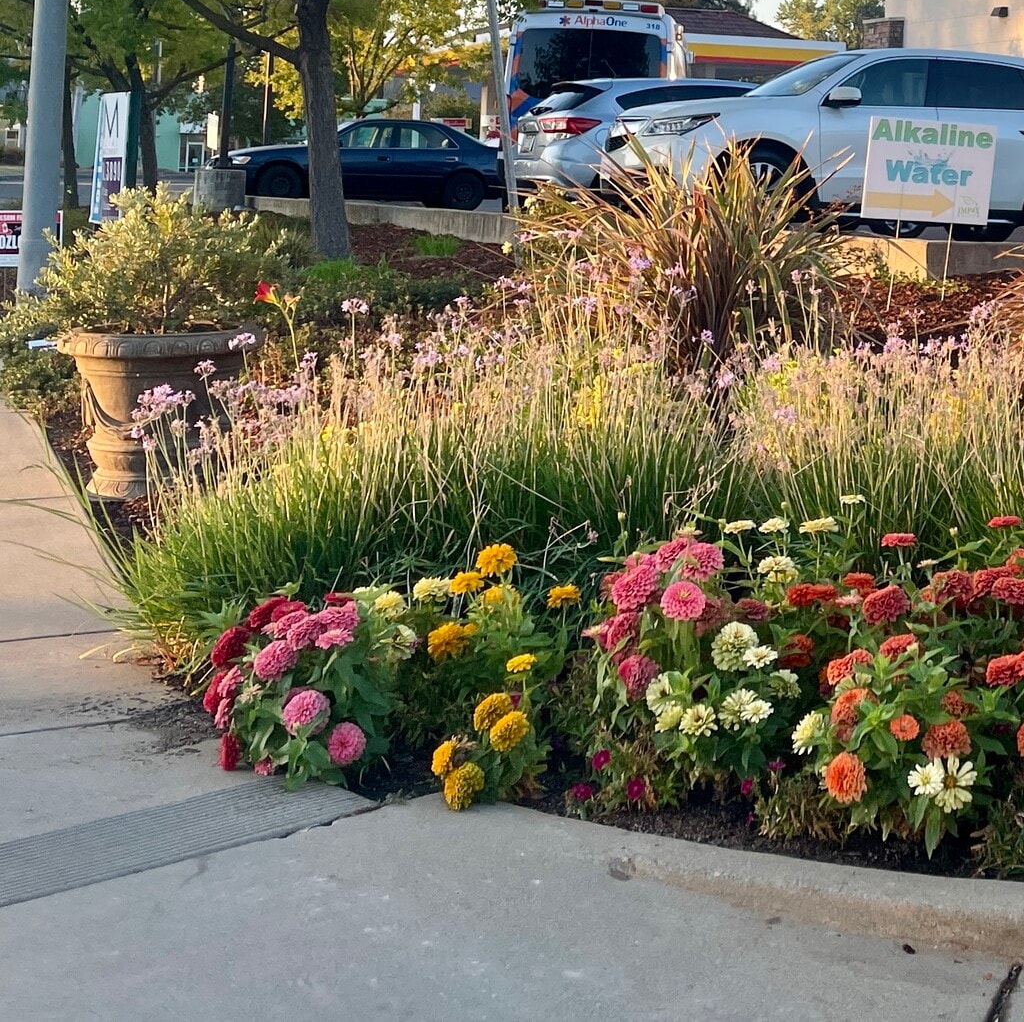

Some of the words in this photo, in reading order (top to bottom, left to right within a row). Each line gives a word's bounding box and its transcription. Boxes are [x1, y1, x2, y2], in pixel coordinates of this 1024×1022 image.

[574, 15, 628, 28] AlphaOne
[872, 118, 994, 149] Alkaline
[885, 159, 974, 187] Water
